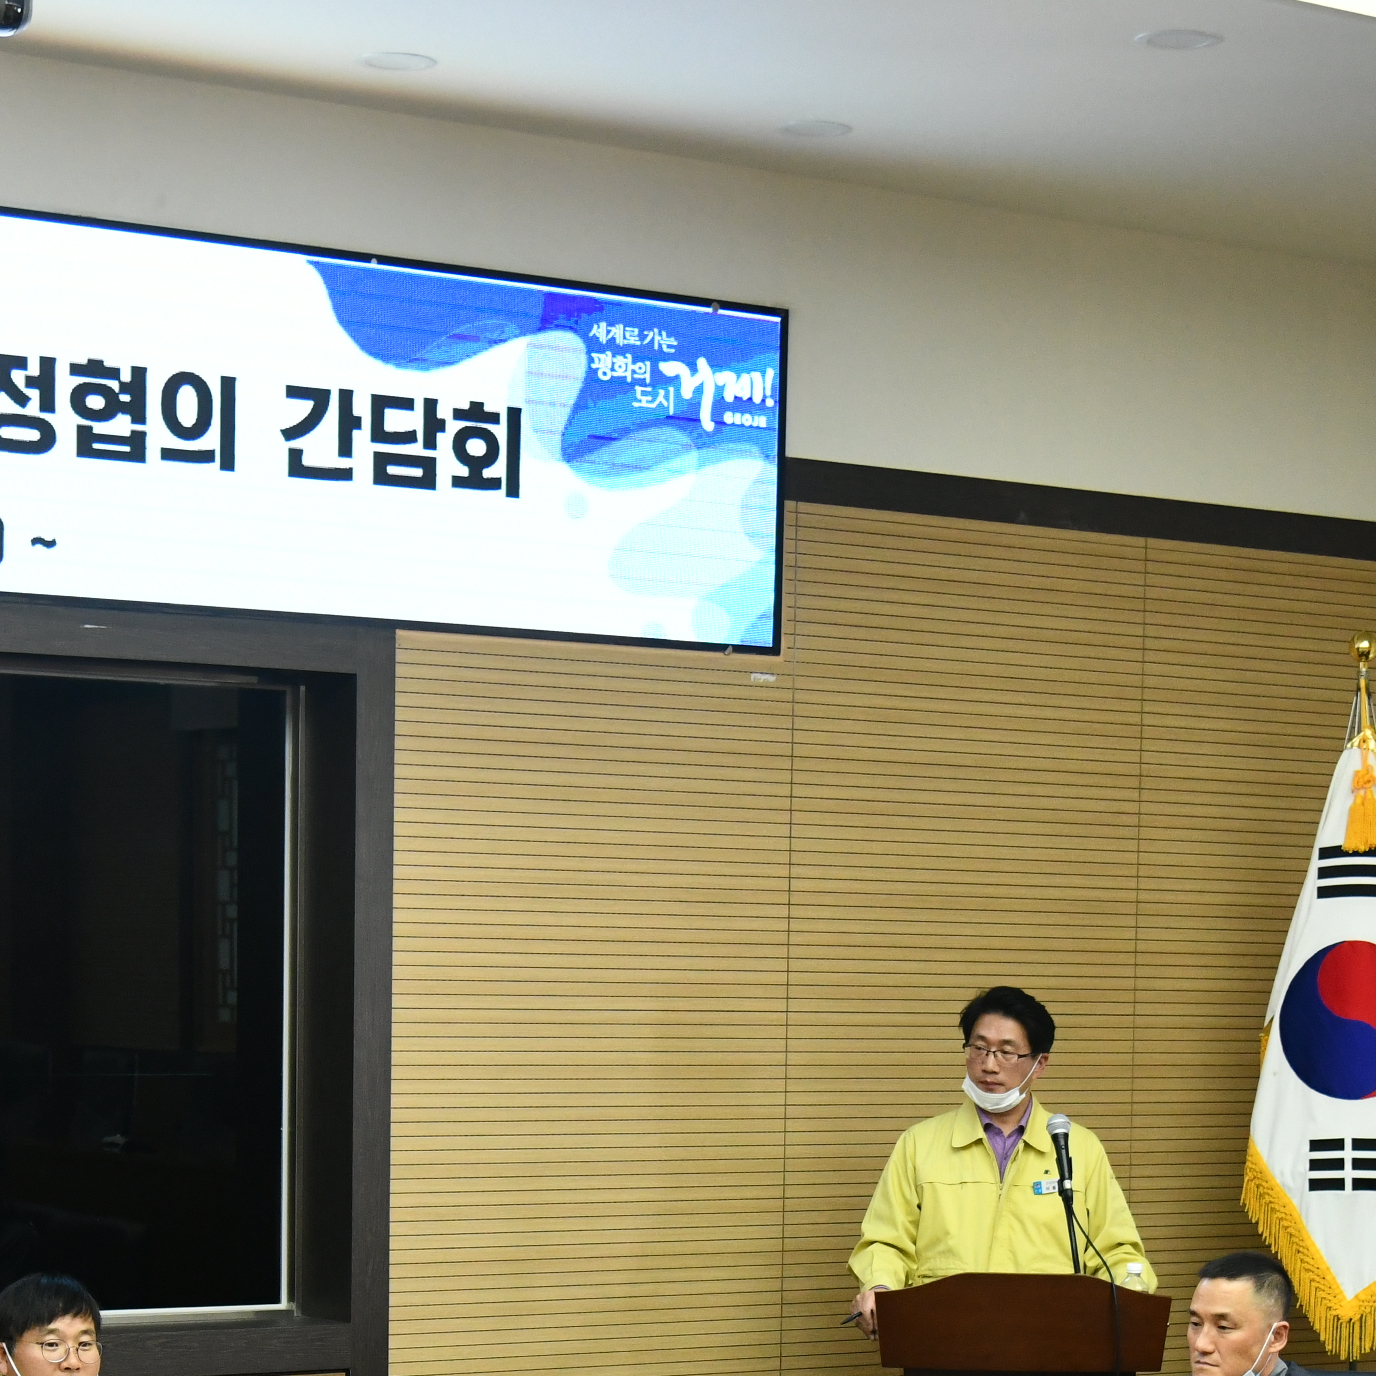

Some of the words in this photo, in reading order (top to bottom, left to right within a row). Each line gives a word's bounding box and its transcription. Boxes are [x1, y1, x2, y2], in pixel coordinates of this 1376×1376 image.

[588, 321, 641, 347] 세계로
[642, 327, 678, 352] 가는
[590, 351, 651, 383] 평화의
[632, 385, 674, 415] 도시
[279, 384, 523, 499] 간담회
